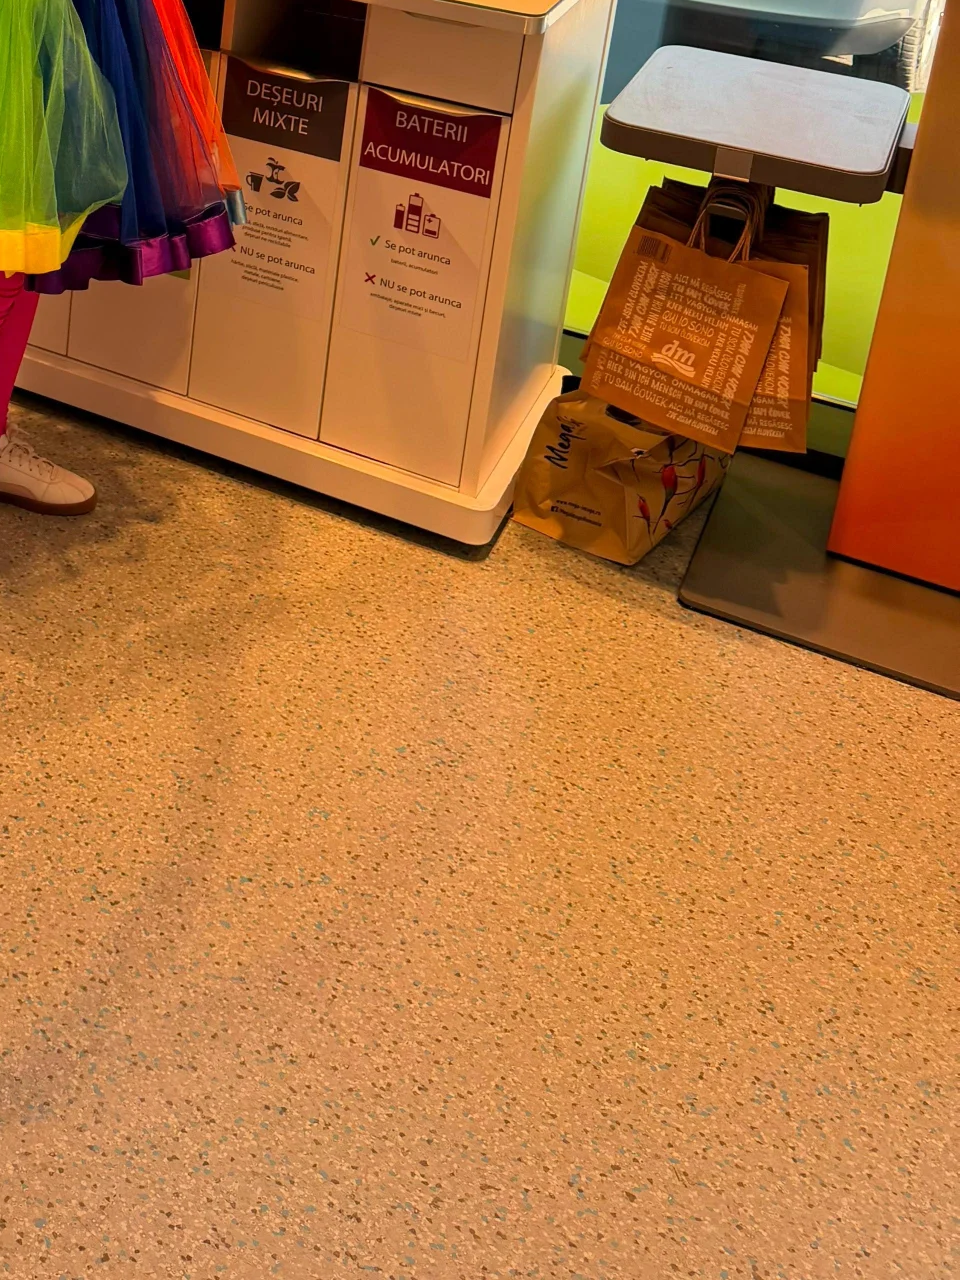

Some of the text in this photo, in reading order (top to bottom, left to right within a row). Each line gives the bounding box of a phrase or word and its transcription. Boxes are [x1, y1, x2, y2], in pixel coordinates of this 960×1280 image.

[246, 79, 324, 113] DEȘEURI
[253, 107, 309, 136] MIXTE
[395, 110, 467, 143] BATERII
[364, 141, 490, 186] ACUMULATORI
[244, 203, 303, 226] Se pot arunca
[240, 246, 315, 274] NU se pot arunca
[385, 240, 451, 265] Se pot arunca
[380, 278, 462, 309] NU se pot arunca
[687, 298, 716, 315] VAGYOK
[640, 326, 654, 342] HIER
[688, 321, 714, 337] SONO
[622, 346, 642, 357] SONO
[661, 340, 695, 365] dm
[607, 360, 623, 374] HIER
[625, 369, 636, 380] BIN
[638, 374, 650, 385] ICH
[651, 380, 682, 399] MENSCH
[610, 352, 625, 363] ITT
[630, 361, 666, 381] VAGYOK
[605, 373, 615, 384] TU
[615, 378, 633, 392] SAM
[634, 384, 668, 407] ČOVJEK
[544, 423, 587, 469] Mega
